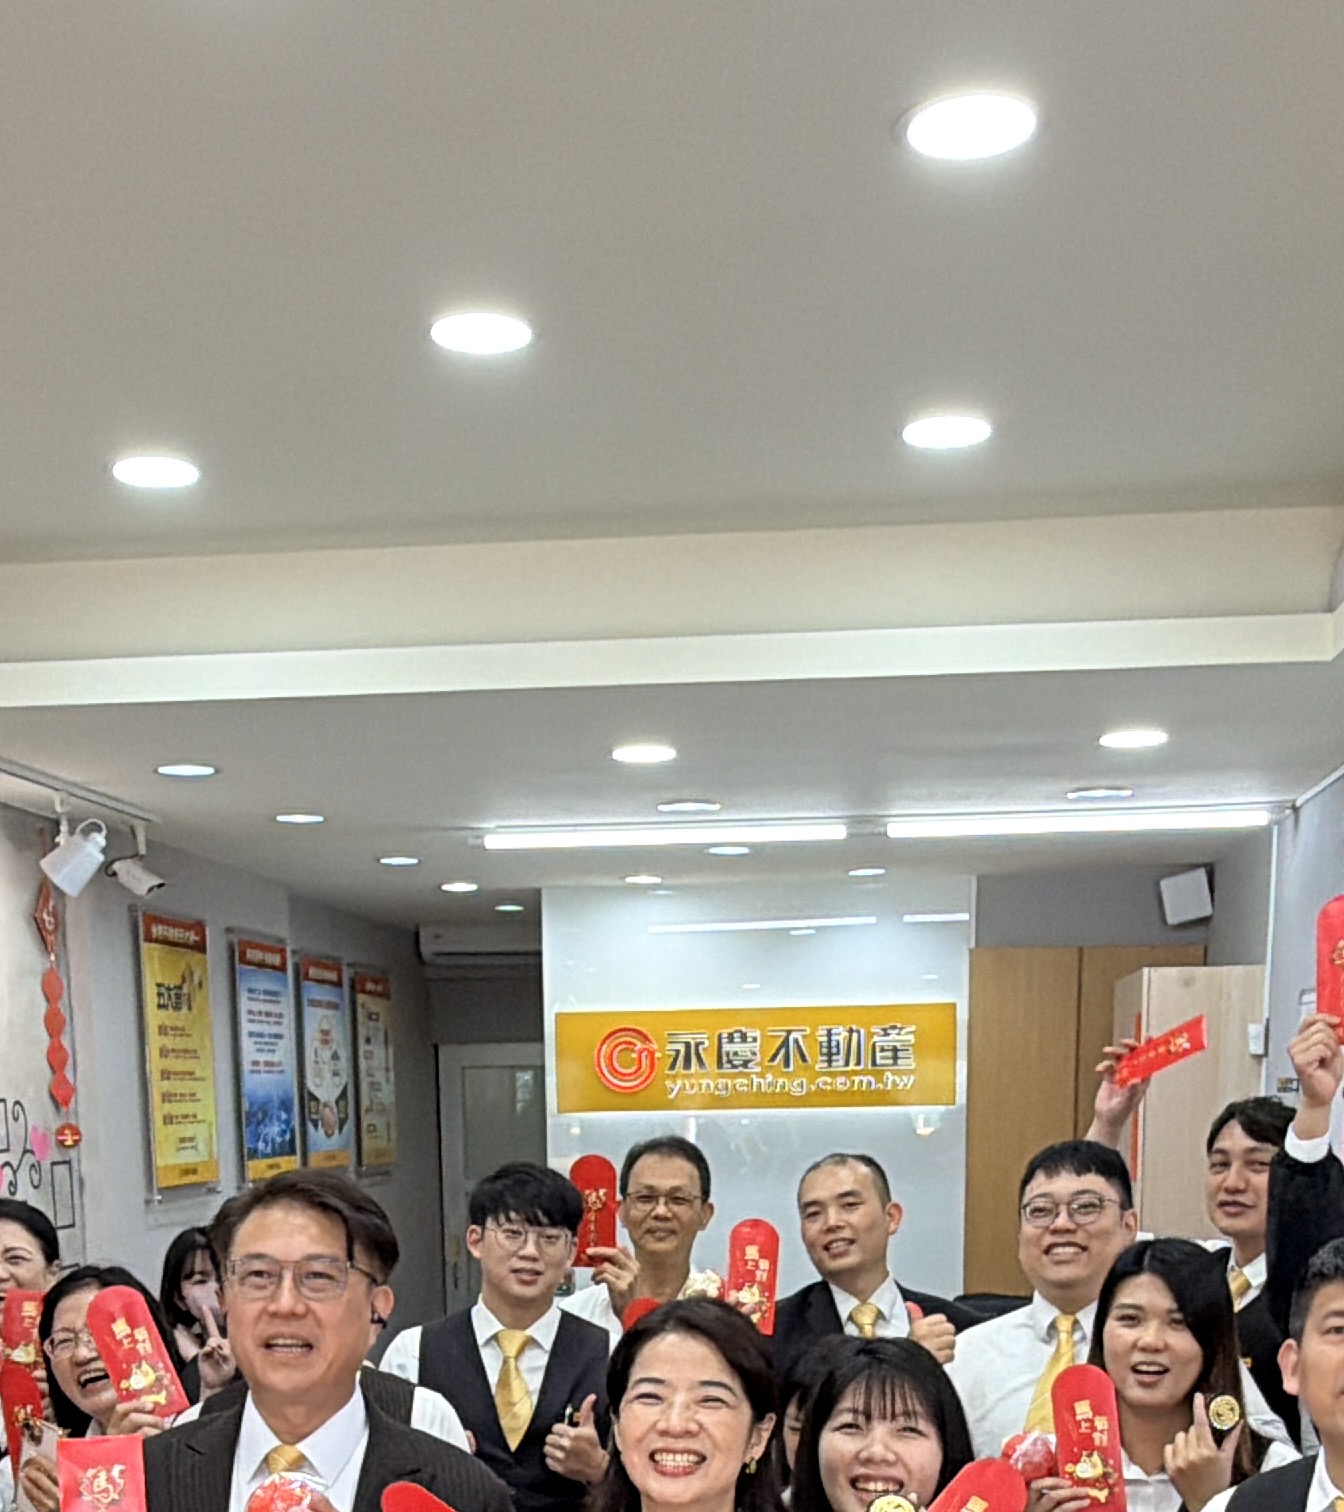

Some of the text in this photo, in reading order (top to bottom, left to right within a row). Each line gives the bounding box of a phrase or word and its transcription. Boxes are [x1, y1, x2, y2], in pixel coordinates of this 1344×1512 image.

[665, 1025, 917, 1073] 永慶不動產
[664, 1071, 916, 1098] yungching.com.tw
